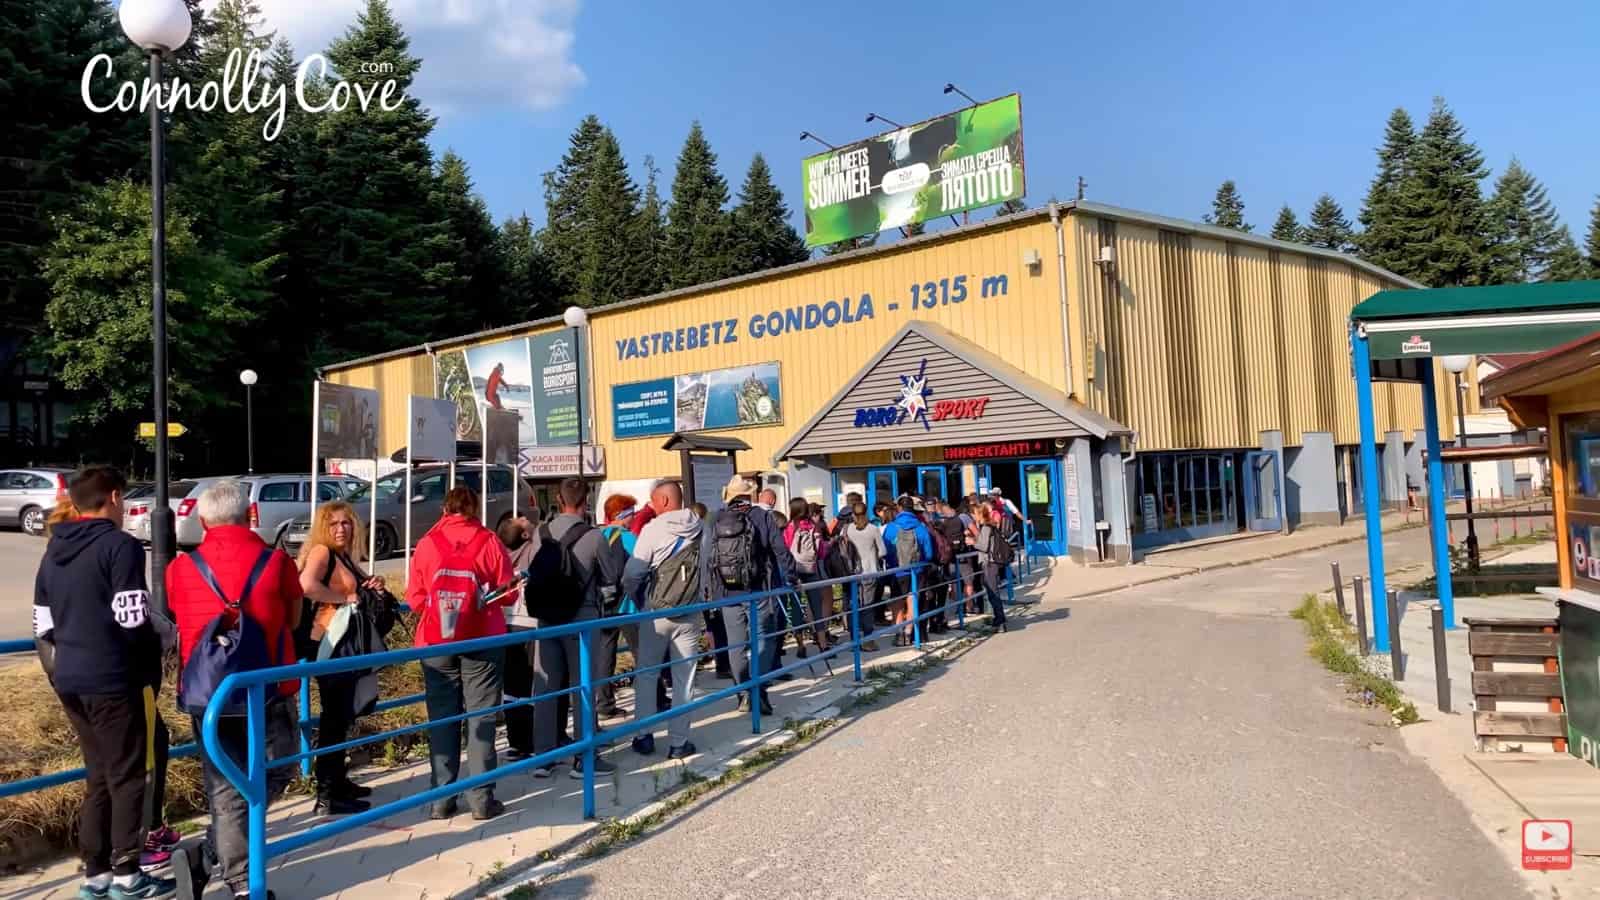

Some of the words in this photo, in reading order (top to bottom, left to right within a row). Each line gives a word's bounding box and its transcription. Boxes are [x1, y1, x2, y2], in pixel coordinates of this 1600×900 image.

[841, 147, 869, 171] MEETS
[941, 155, 975, 178] ЗИМАТА
[808, 164, 871, 210] SUMMER
[941, 162, 1013, 212] ЛЯТОТО
[616, 318, 738, 360] YASTREBETZ
[749, 293, 874, 339] GONDOLA
[910, 274, 968, 310] 1315
[981, 274, 1008, 298] m
[853, 406, 897, 428] BORO
[931, 396, 991, 421] SPORT
[892, 450, 912, 461] WC
